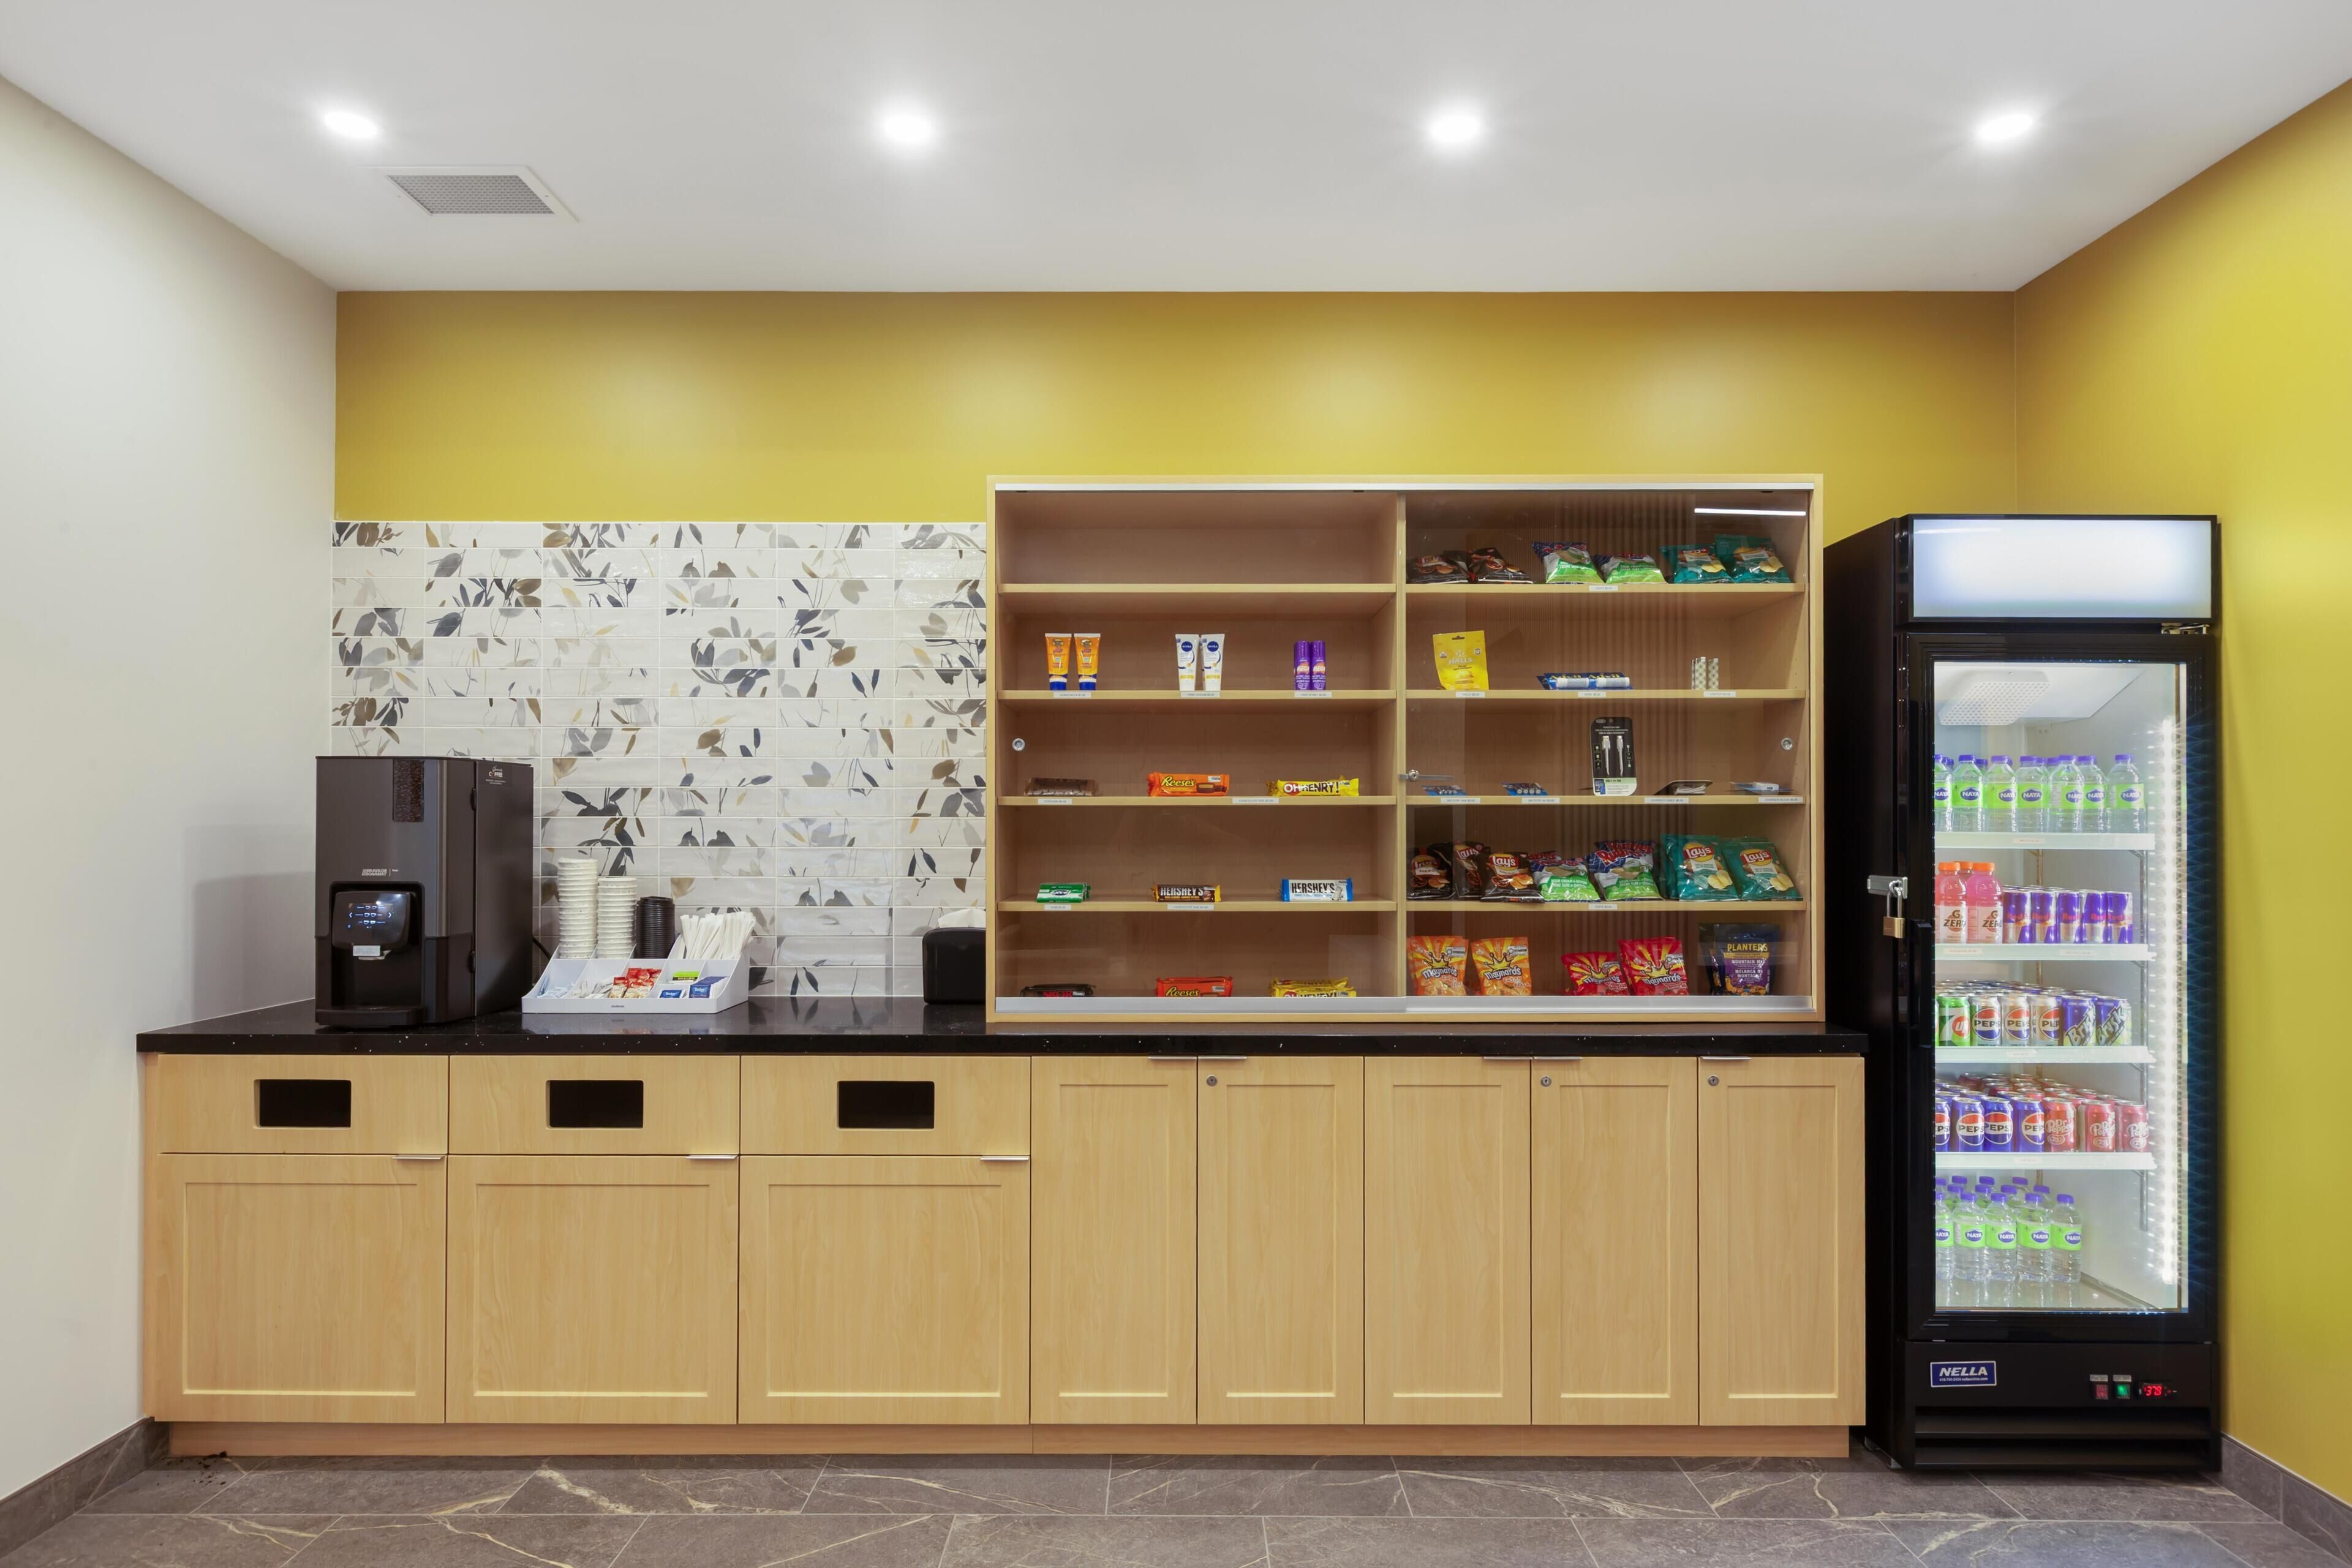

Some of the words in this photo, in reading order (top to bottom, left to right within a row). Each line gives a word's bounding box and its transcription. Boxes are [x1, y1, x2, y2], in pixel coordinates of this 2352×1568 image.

[1161, 776, 1195, 787] Reese's
[1686, 847, 1711, 858] Lay's
[1744, 851, 1770, 863] Lay's
[1492, 856, 1517, 867] Lay's
[1291, 882, 1335, 893] HERSHEY'S
[1952, 910, 1961, 918] G
[1422, 968, 1458, 979] Maynards
[1484, 967, 1521, 980] Maynards
[1643, 974, 1681, 986] Maynards
[1166, 986, 1199, 997] Reese's
[1939, 1366, 1988, 1377] NELLA
